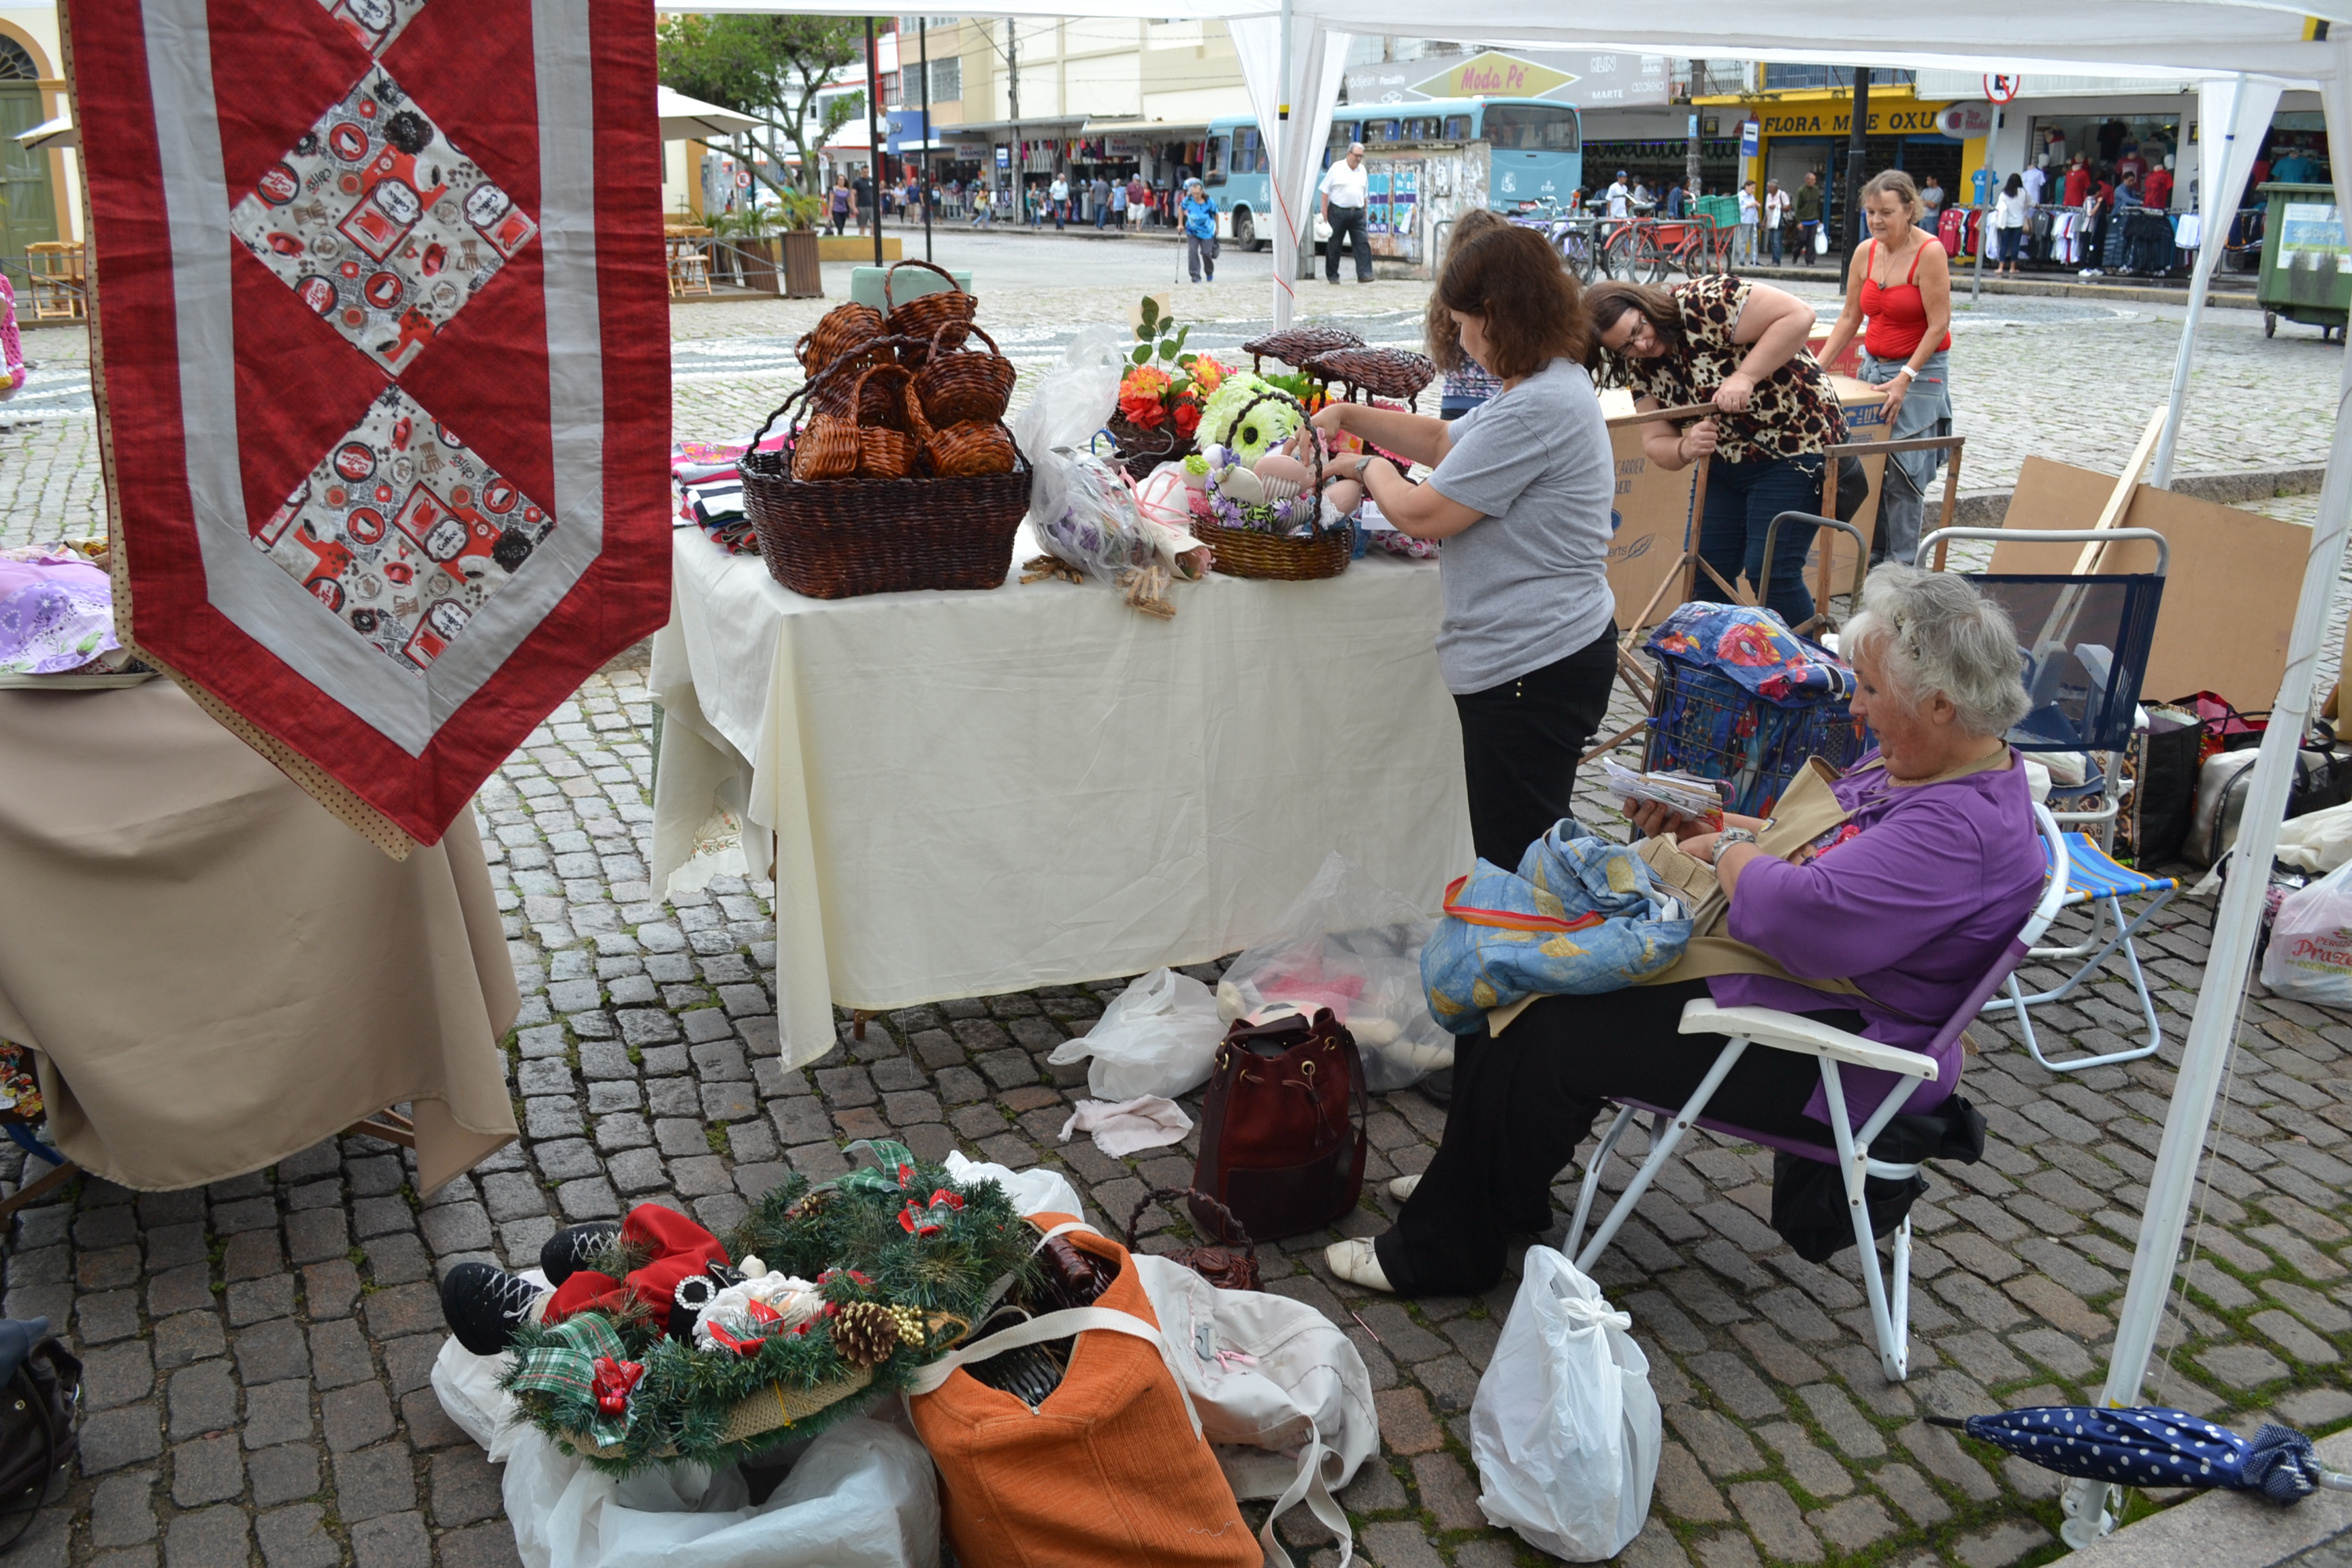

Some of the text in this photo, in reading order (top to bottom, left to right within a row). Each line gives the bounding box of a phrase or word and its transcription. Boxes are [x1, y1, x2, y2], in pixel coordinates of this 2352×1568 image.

[1590, 55, 1616, 74] KLIN
[1461, 64, 1529, 91] Moda Pé
[1592, 89, 1623, 100] MARTE
[1763, 115, 1821, 132] FLORA
[1832, 114, 1880, 131] ME
[1966, 110, 1980, 120] Top
[306, 168, 331, 192] Coffee
[387, 190, 410, 213] Coffee
[475, 193, 498, 215] Coffee
[342, 455, 369, 472] Coffee
[452, 454, 475, 479] Coffee
[1615, 457, 1645, 476] CARRIER
[437, 530, 459, 552] Coffee
[442, 610, 463, 632] Coffee
